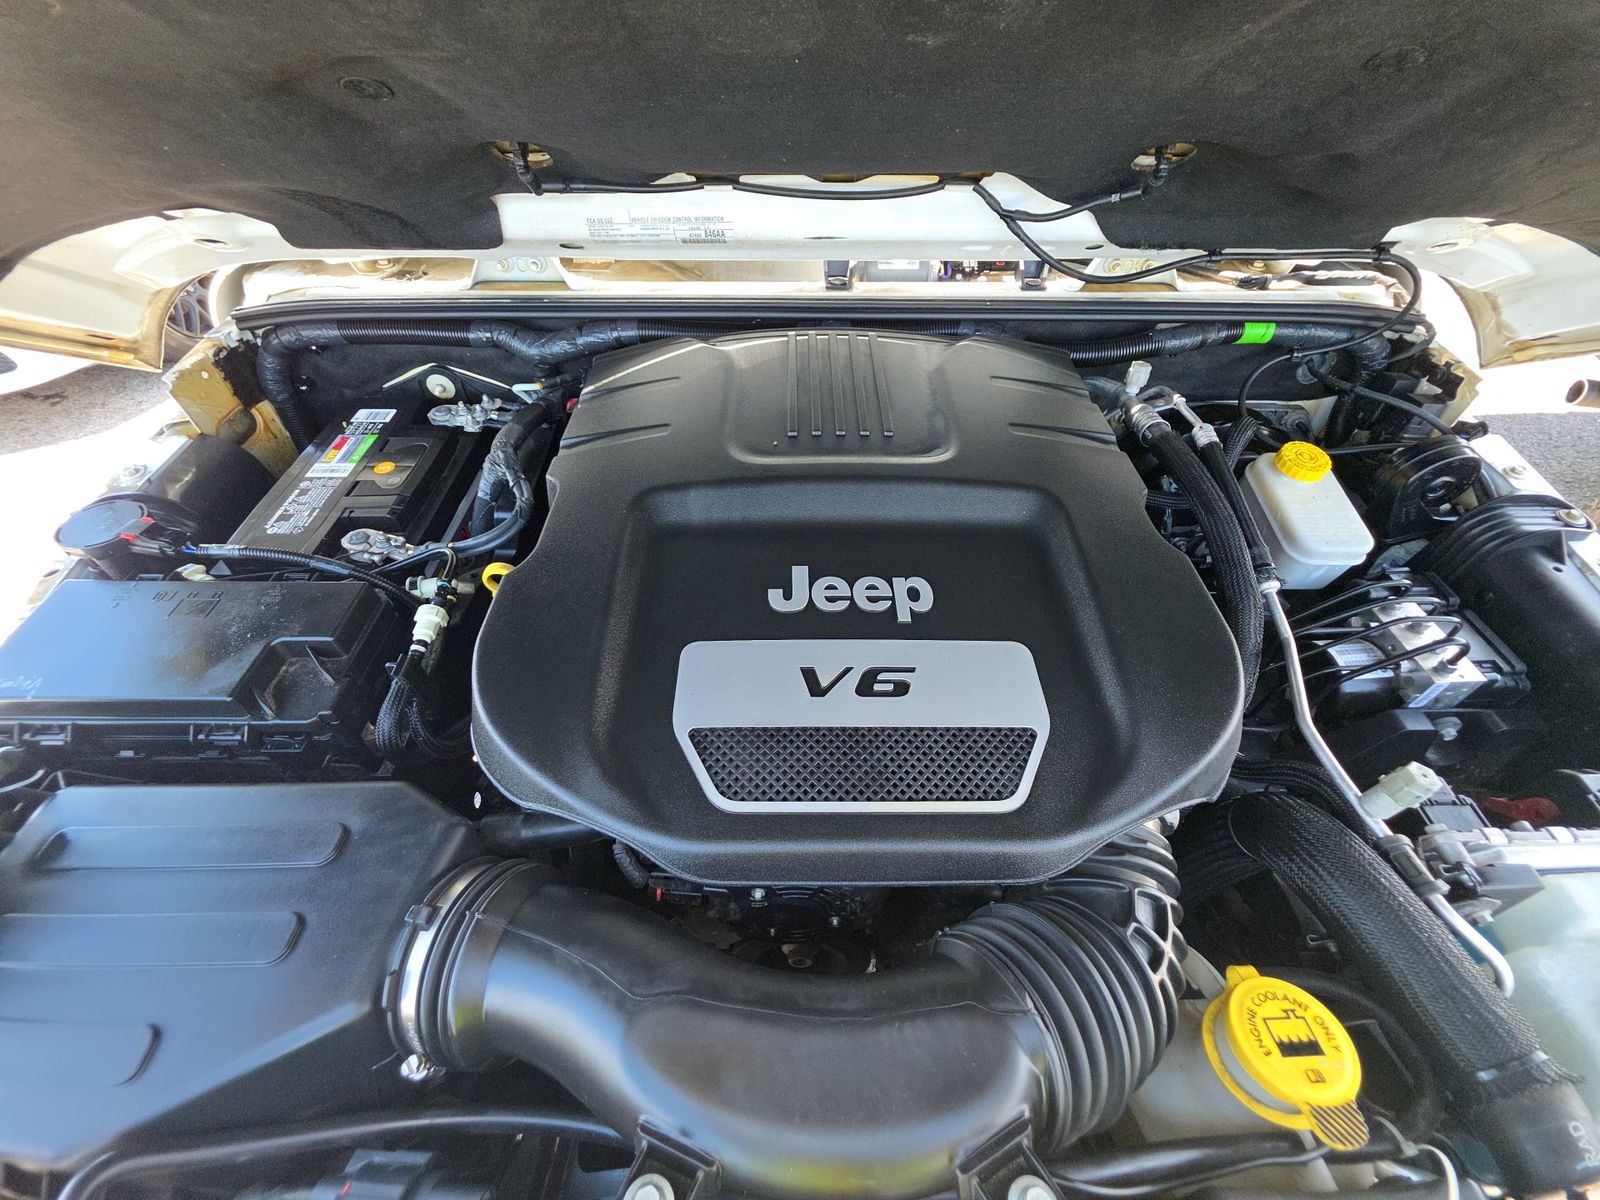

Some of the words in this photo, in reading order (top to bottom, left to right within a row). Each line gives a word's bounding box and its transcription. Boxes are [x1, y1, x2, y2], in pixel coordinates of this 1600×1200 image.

[768, 565, 934, 623] Jeep
[800, 667, 917, 698] V6
[1251, 990, 1310, 1012] COOLANT
[1247, 1006, 1273, 1057] ENGINE
[1313, 1015, 1342, 1054] ONLY
